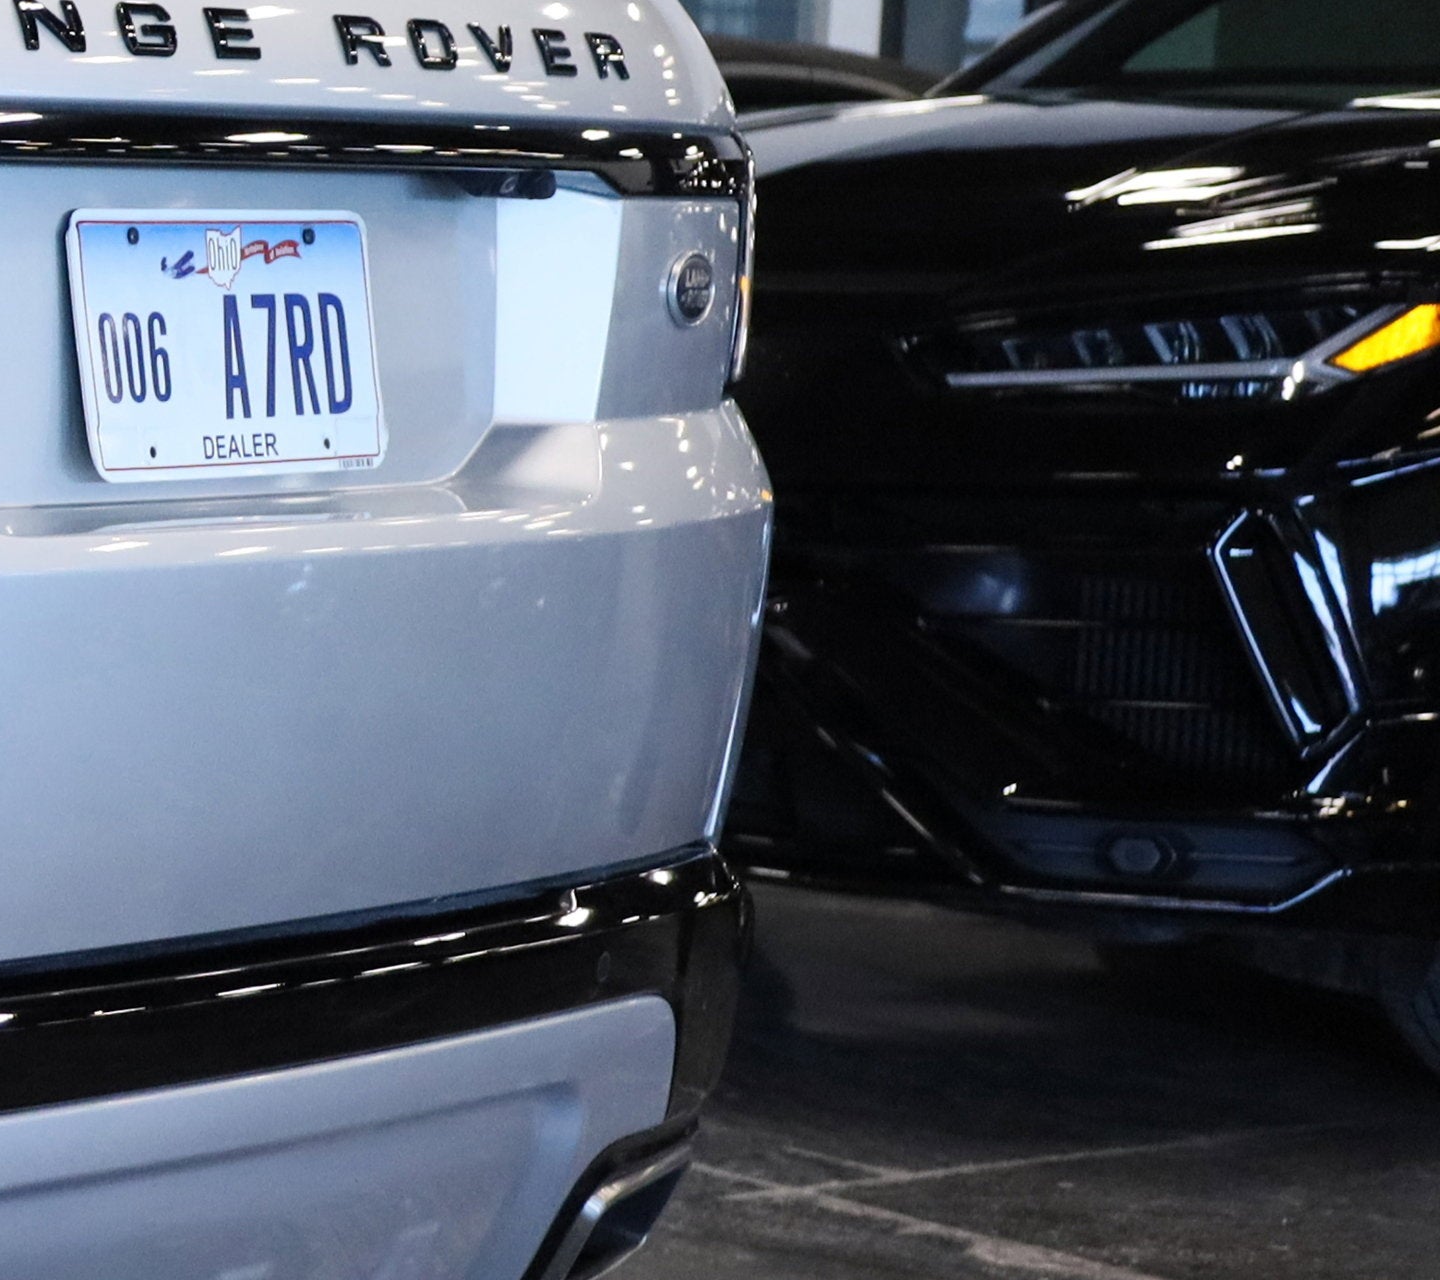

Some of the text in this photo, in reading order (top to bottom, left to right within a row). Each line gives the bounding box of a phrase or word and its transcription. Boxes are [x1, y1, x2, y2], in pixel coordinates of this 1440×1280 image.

[332, 13, 631, 81] ROVER
[97, 292, 353, 420] 006 A7RD
[202, 432, 280, 460] DEALER
